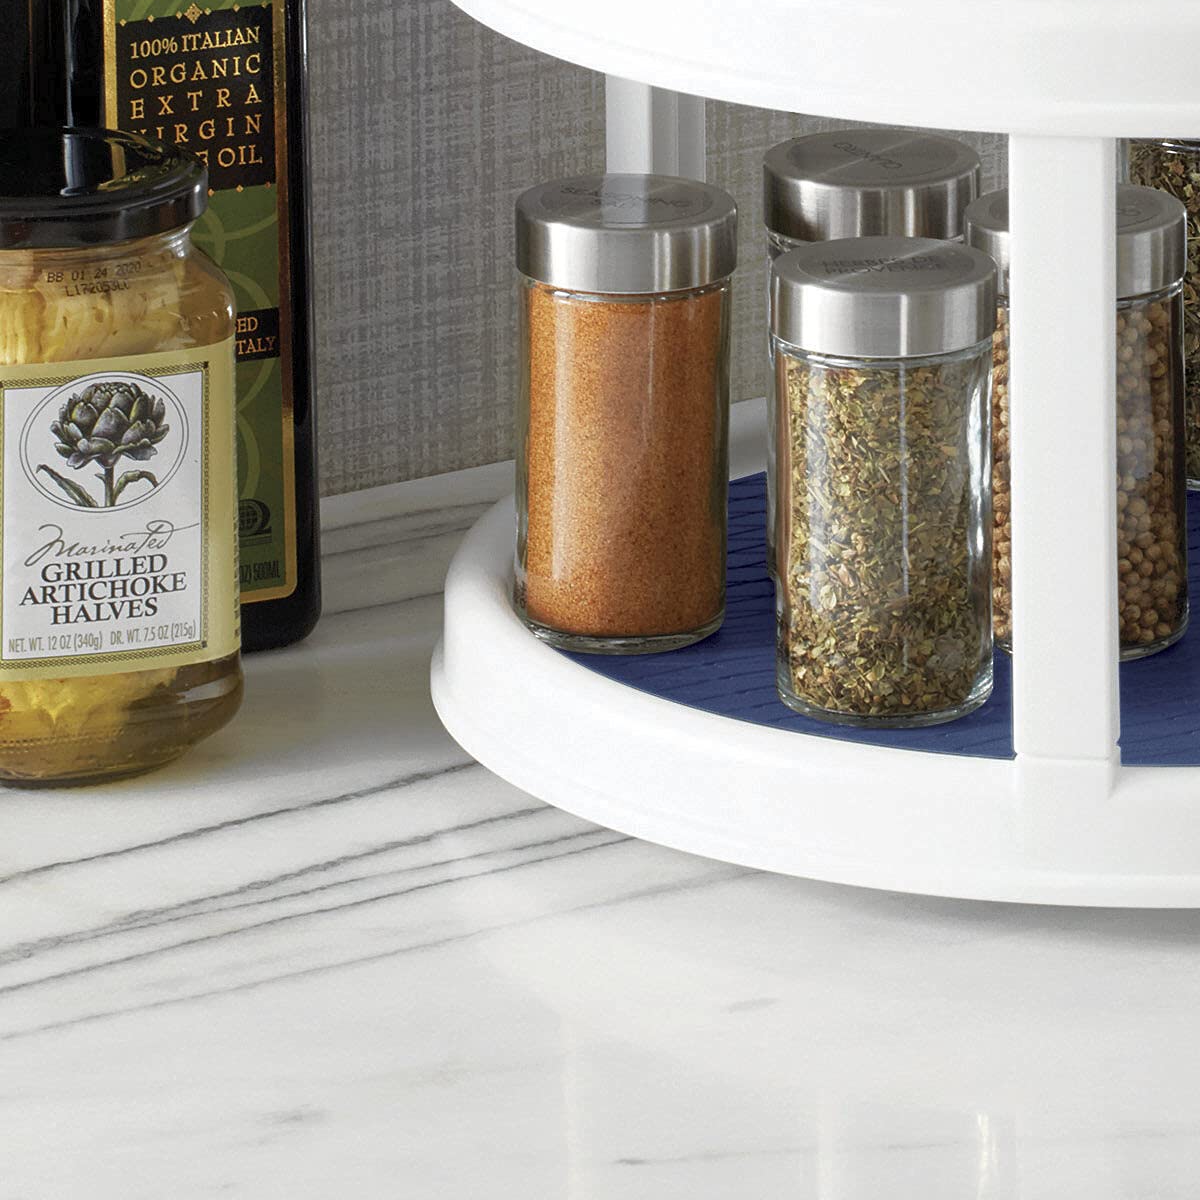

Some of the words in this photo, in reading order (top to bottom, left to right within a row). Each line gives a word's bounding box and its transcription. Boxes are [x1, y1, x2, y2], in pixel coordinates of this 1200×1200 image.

[130, 33, 179, 59] 100%
[182, 26, 260, 52] ITALIAN
[129, 54, 261, 89] ORGANIC
[130, 83, 262, 120] EXTRA
[132, 114, 262, 143] IRGIN
[218, 145, 263, 167] OIL
[47, 272, 64, 283] BB
[24, 520, 200, 567] Marinated
[41, 553, 168, 583] GRILLED
[19, 571, 188, 606] ARTICHOKE
[50, 597, 158, 625] HALVES
[8, 638, 26, 653] NET.
[29, 637, 45, 651] WT.
[48, 636, 57, 650] 12
[59, 635, 72, 650] OZ
[73, 632, 103, 651] (340g)
[110, 631, 124, 646] DR.
[127, 628, 142, 643] WT.
[143, 626, 156, 641] 7.5
[157, 625, 169, 640] OZ
[171, 621, 197, 642] (215g)
